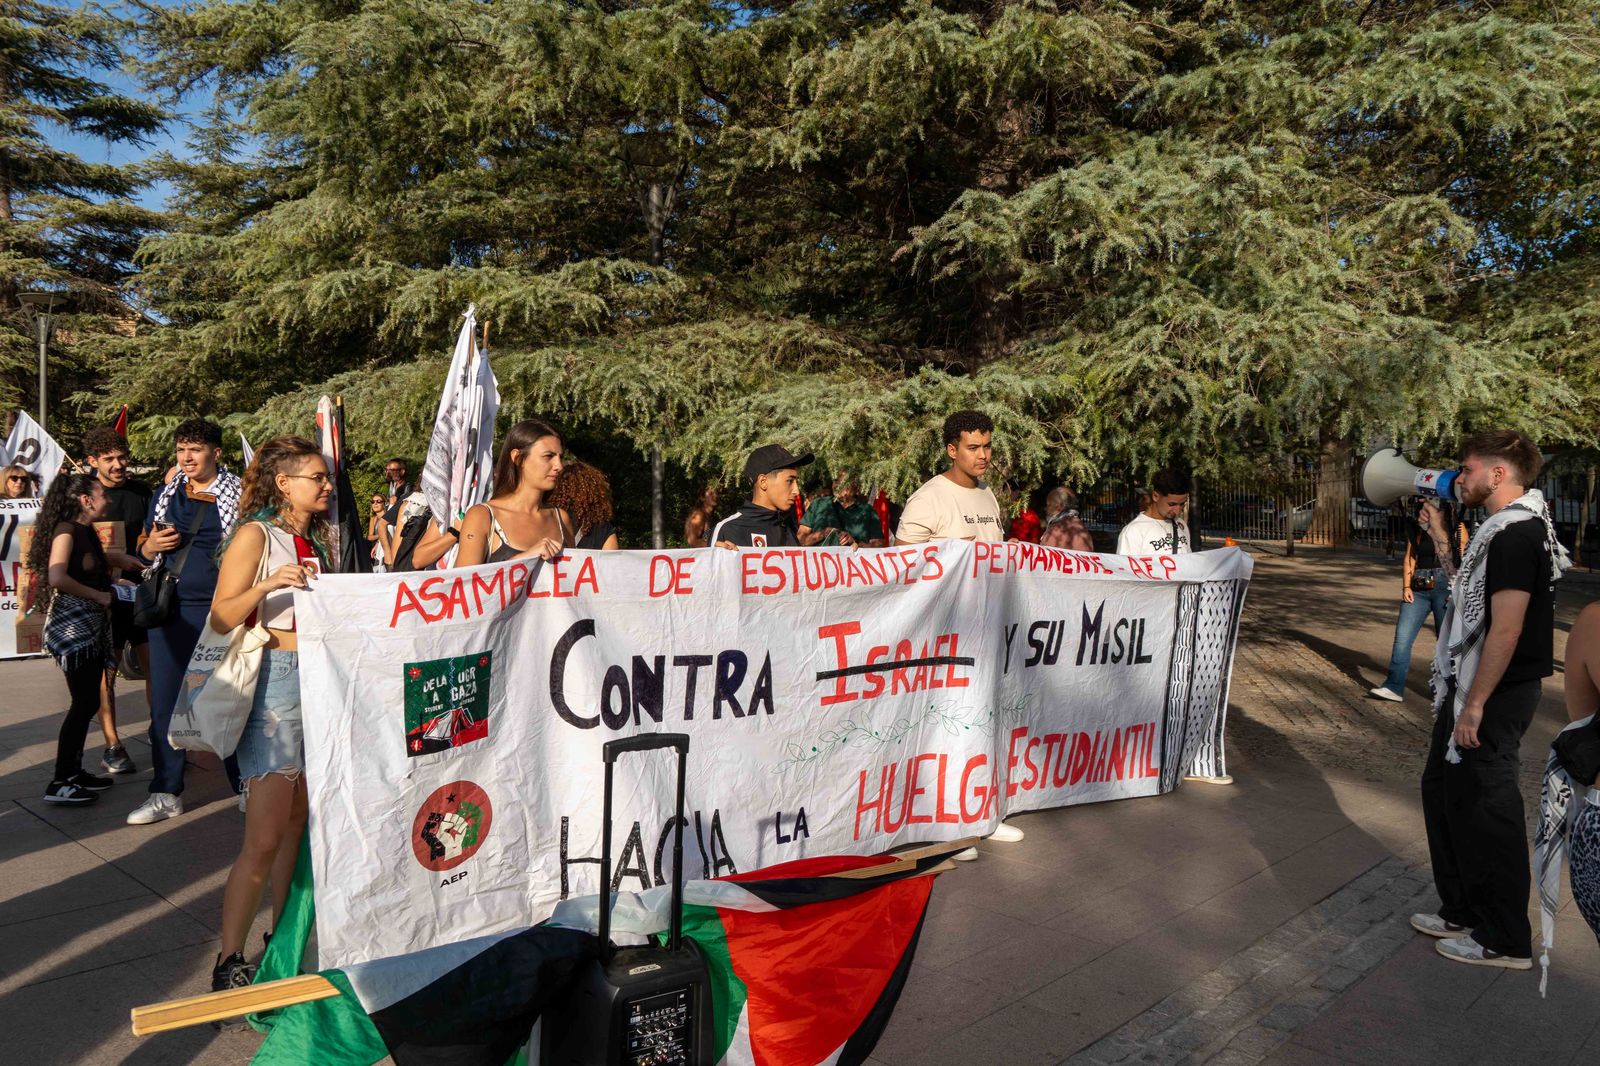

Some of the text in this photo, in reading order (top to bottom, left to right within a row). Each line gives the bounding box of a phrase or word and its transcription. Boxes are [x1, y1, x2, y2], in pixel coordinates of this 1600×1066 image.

[390, 556, 599, 628] ASAMBLEA
[649, 554, 695, 597] DE
[742, 546, 944, 595] ESTUDIANTES
[973, 541, 1114, 578] PERMANENTE
[1127, 555, 1177, 580] AEP
[422, 666, 476, 693] DE LA UGR
[432, 680, 478, 704] A GAZA
[549, 618, 775, 731] CONTRA
[817, 620, 971, 706] ISRAEL
[1025, 619, 1065, 668] SU
[560, 722, 1160, 901] HACIA LA HUELGA ESTUDIANTIL
[440, 870, 469, 889] AEP
